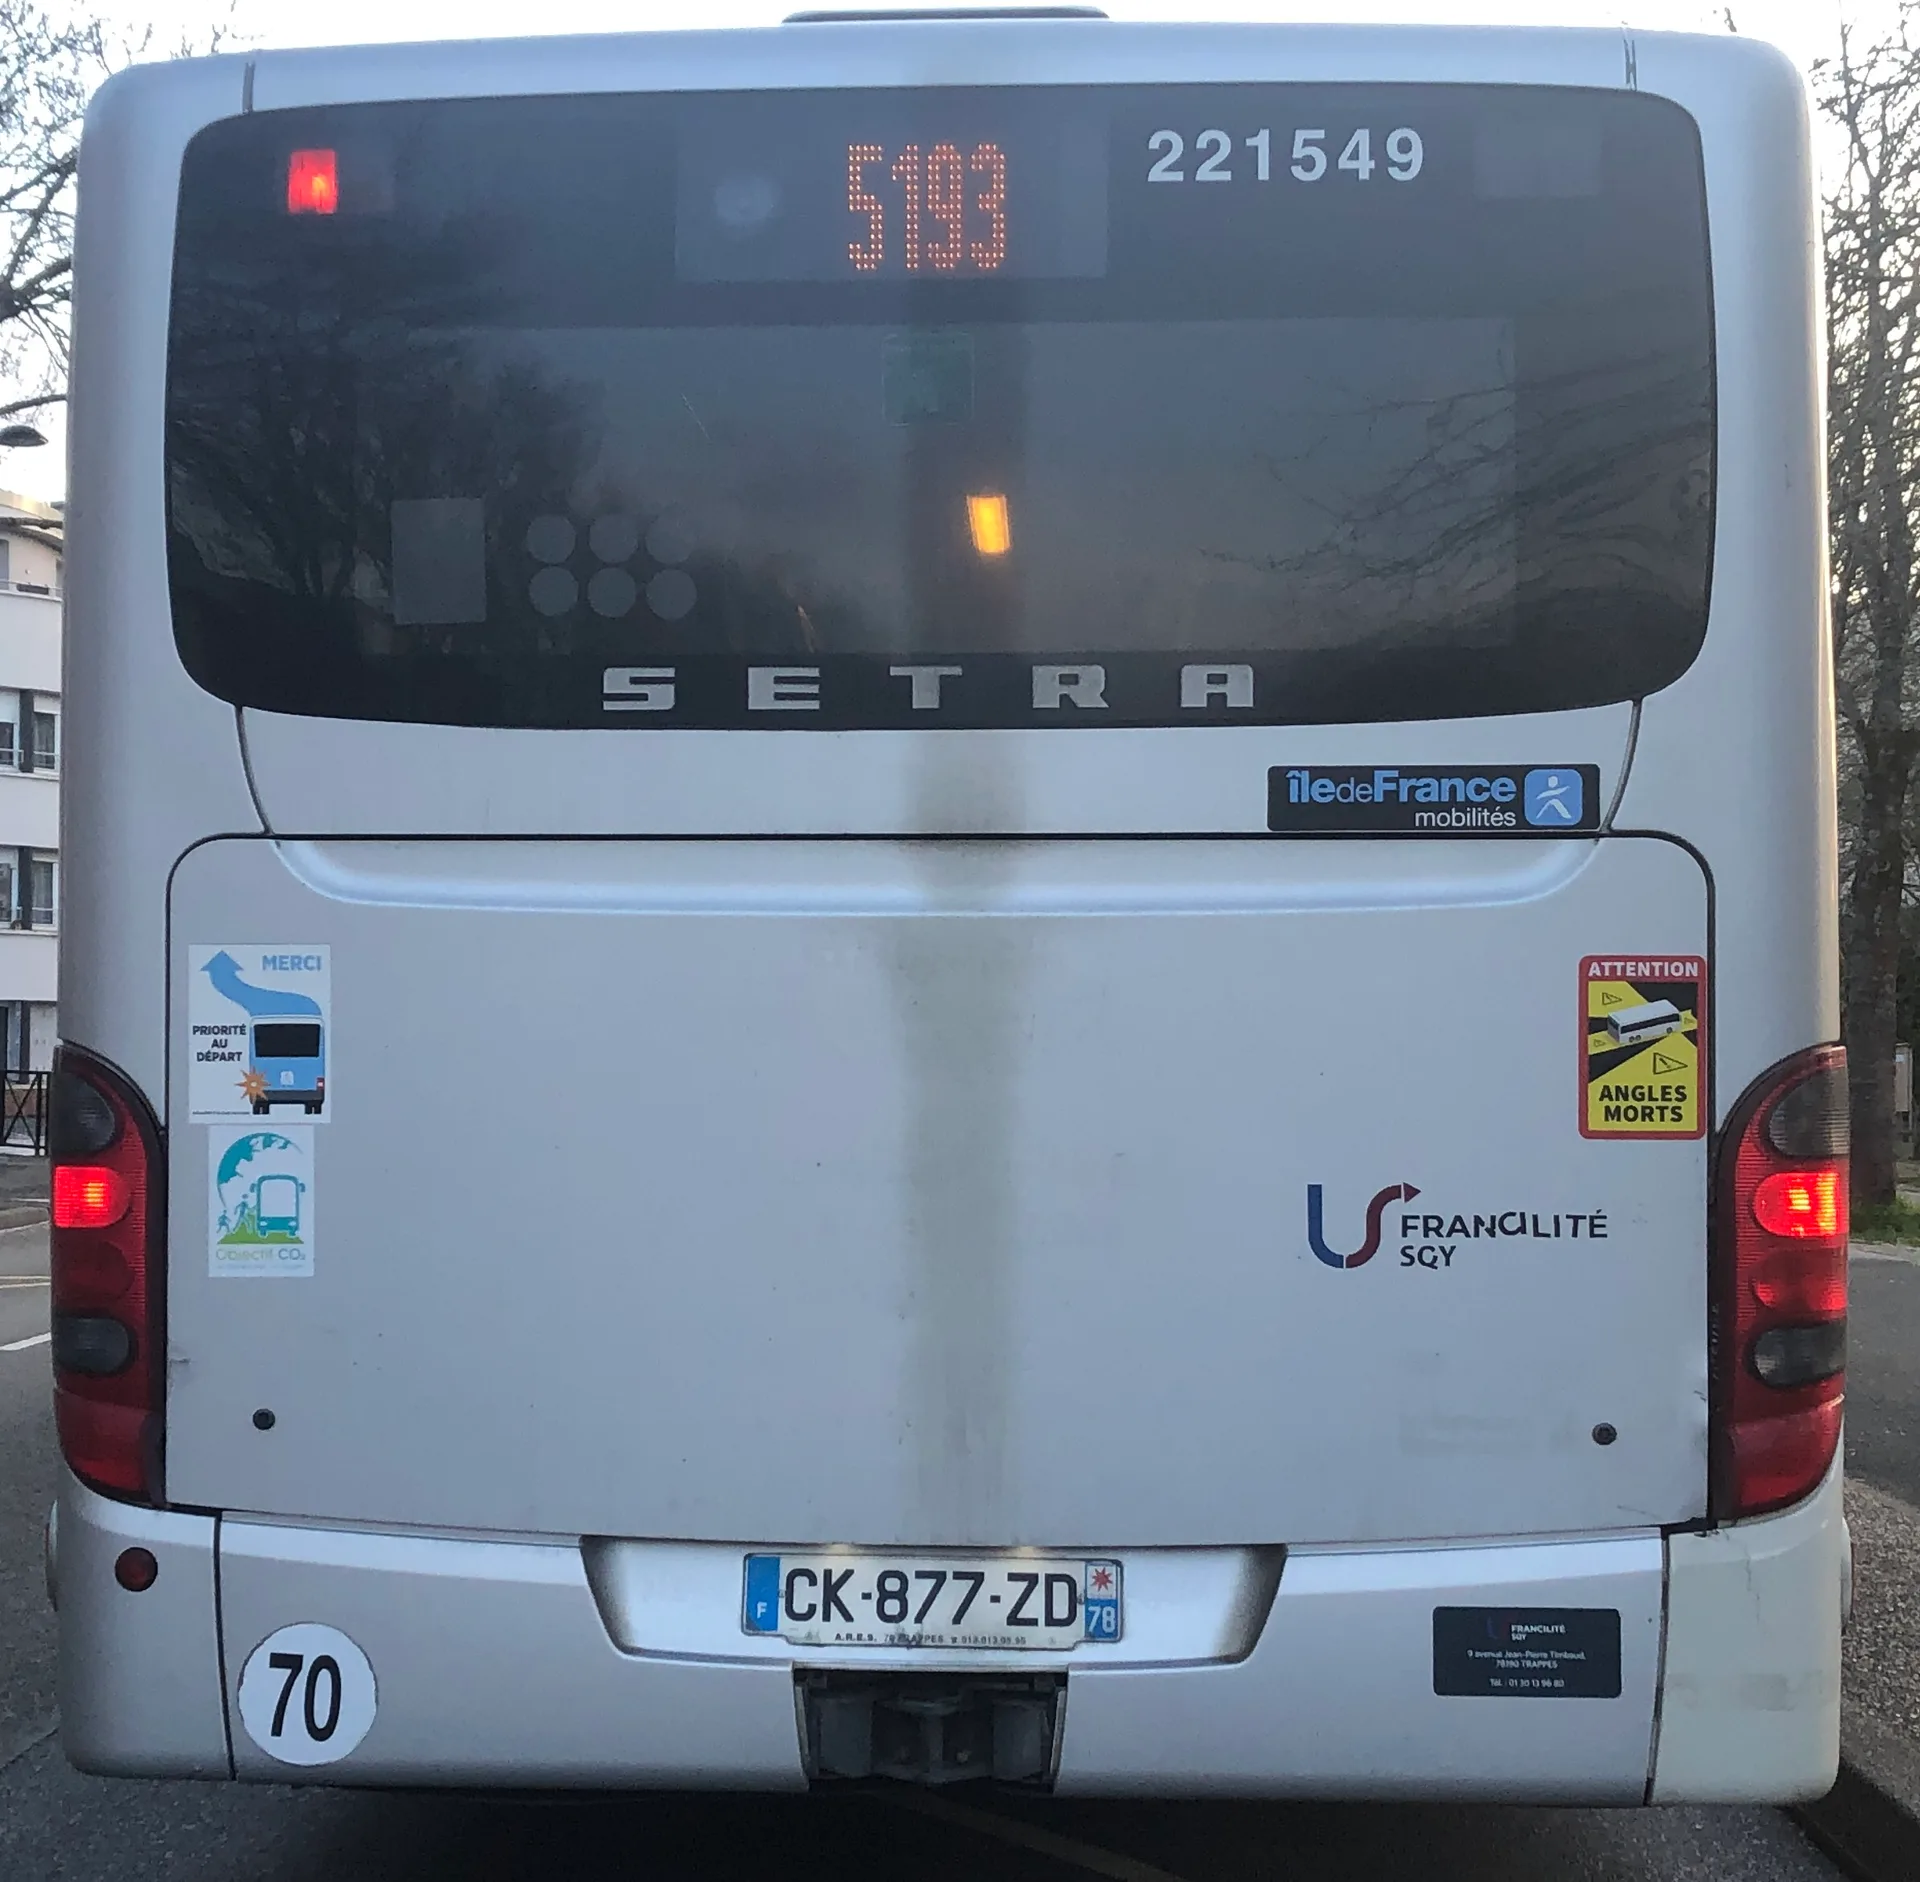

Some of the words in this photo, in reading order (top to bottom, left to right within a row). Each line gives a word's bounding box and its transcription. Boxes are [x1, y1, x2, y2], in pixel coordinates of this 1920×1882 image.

[1147, 127, 1425, 182] 221549
[847, 143, 1006, 271] 5193
[602, 664, 1255, 711] SETRA
[1414, 806, 1517, 828] mobilités
[261, 955, 322, 972] MERCI
[1588, 961, 1699, 978] ATTENTION
[192, 1023, 247, 1036] PRIORITÉ
[210, 1038, 228, 1049] AU
[196, 1050, 243, 1062] DÉPART
[1599, 1085, 1688, 1102] ANGLES
[1603, 1104, 1684, 1123] MORTS
[1400, 1245, 1457, 1270] SQY
[784, 1567, 1078, 1628] CK-877-ZD
[756, 1601, 768, 1619] F
[1087, 1605, 1116, 1634] 78
[268, 1652, 342, 1742] 70
